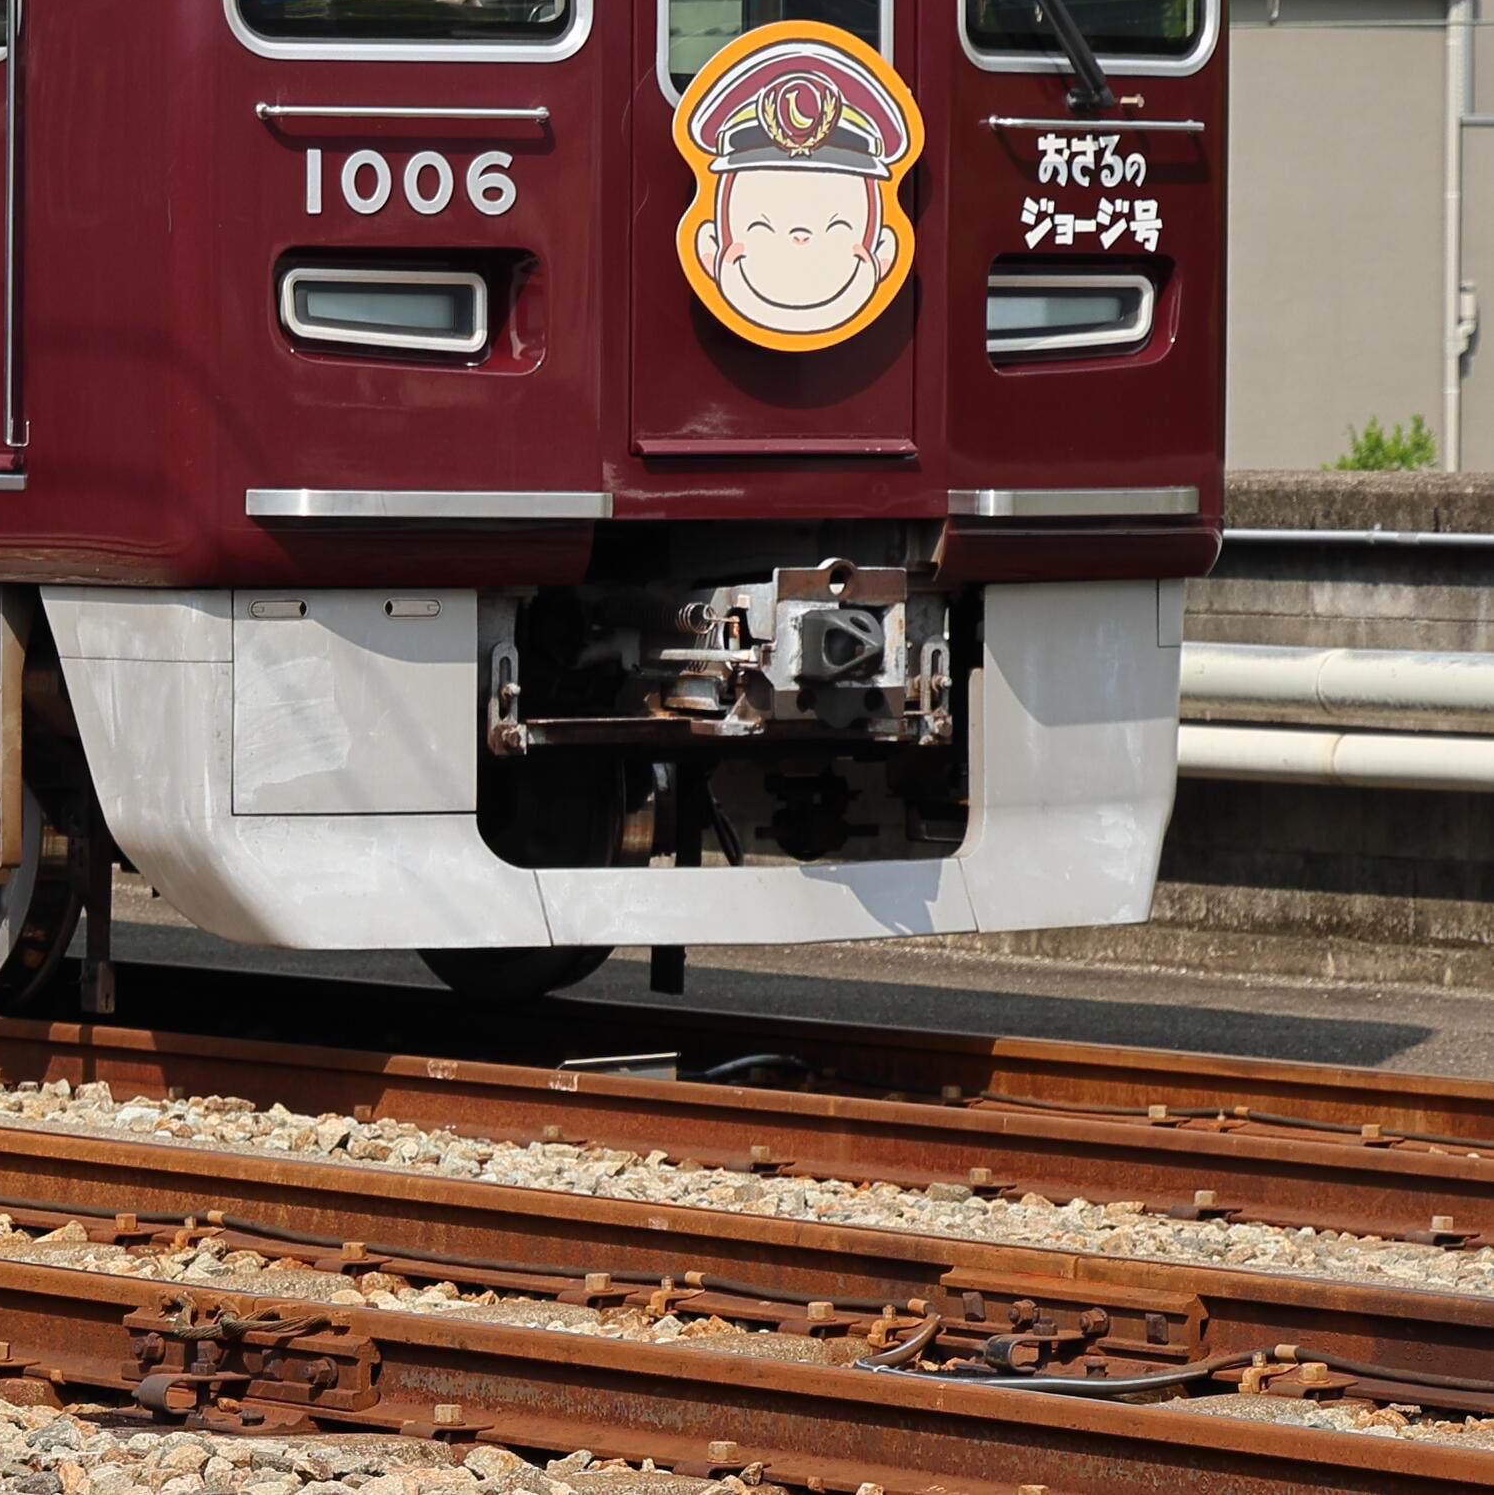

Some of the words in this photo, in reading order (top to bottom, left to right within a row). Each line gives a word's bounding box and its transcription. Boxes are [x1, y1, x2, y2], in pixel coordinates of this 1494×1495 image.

[306, 148, 517, 216] 1006
[1036, 133, 1147, 188] おさるの
[1019, 196, 1163, 253] ジョージ号
